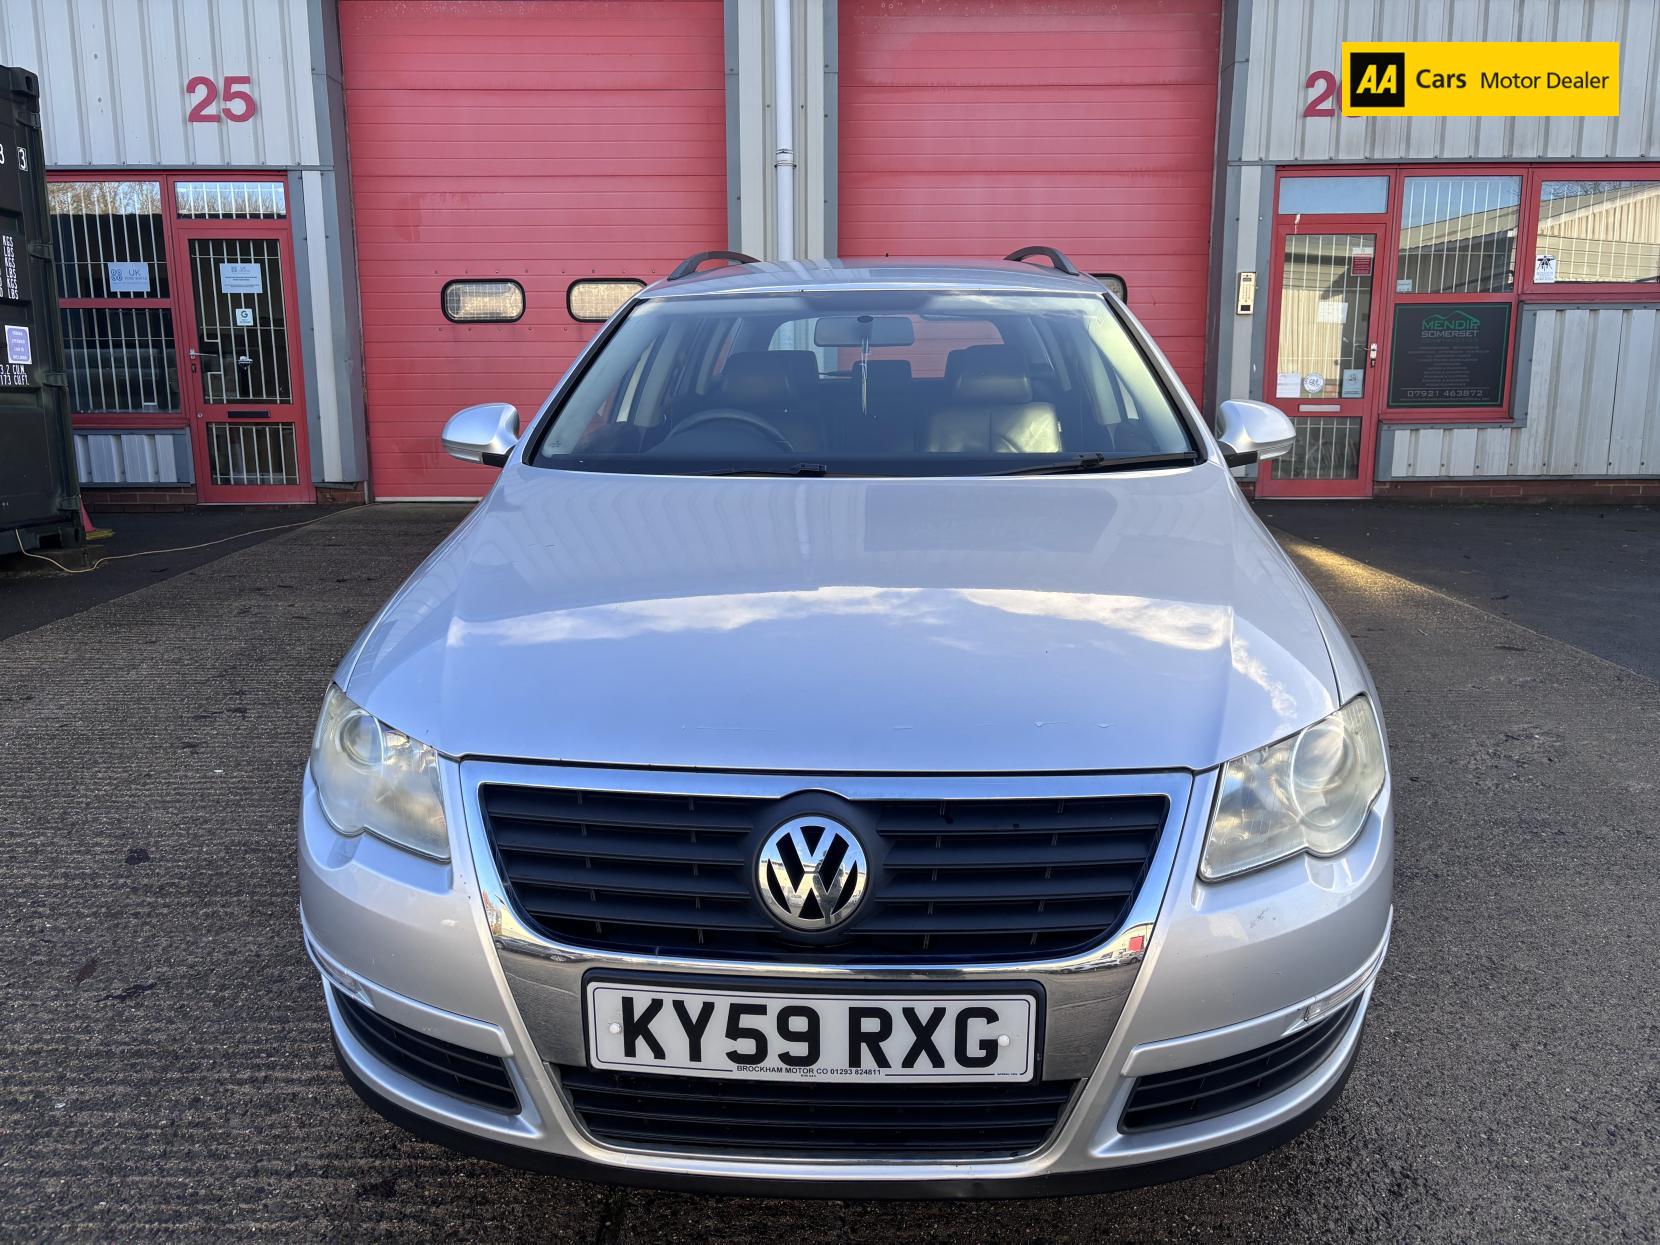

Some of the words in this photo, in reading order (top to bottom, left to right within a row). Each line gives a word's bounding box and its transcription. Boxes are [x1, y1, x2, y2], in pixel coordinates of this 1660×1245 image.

[186, 76, 256, 123] 25
[1303, 70, 1361, 118] 2
[4, 246, 14, 257] LBS
[6, 267, 16, 278] LBS
[128, 268, 141, 277] UK
[8, 288, 19, 300] LBS
[1421, 319, 1480, 330] MENDIP
[1420, 330, 1480, 338] SOMERSET
[621, 996, 820, 1066] KY59
[849, 1006, 1000, 1069] RXG
[736, 1065, 783, 1073] BROCKHAM
[785, 1067, 814, 1075] MOTOR
